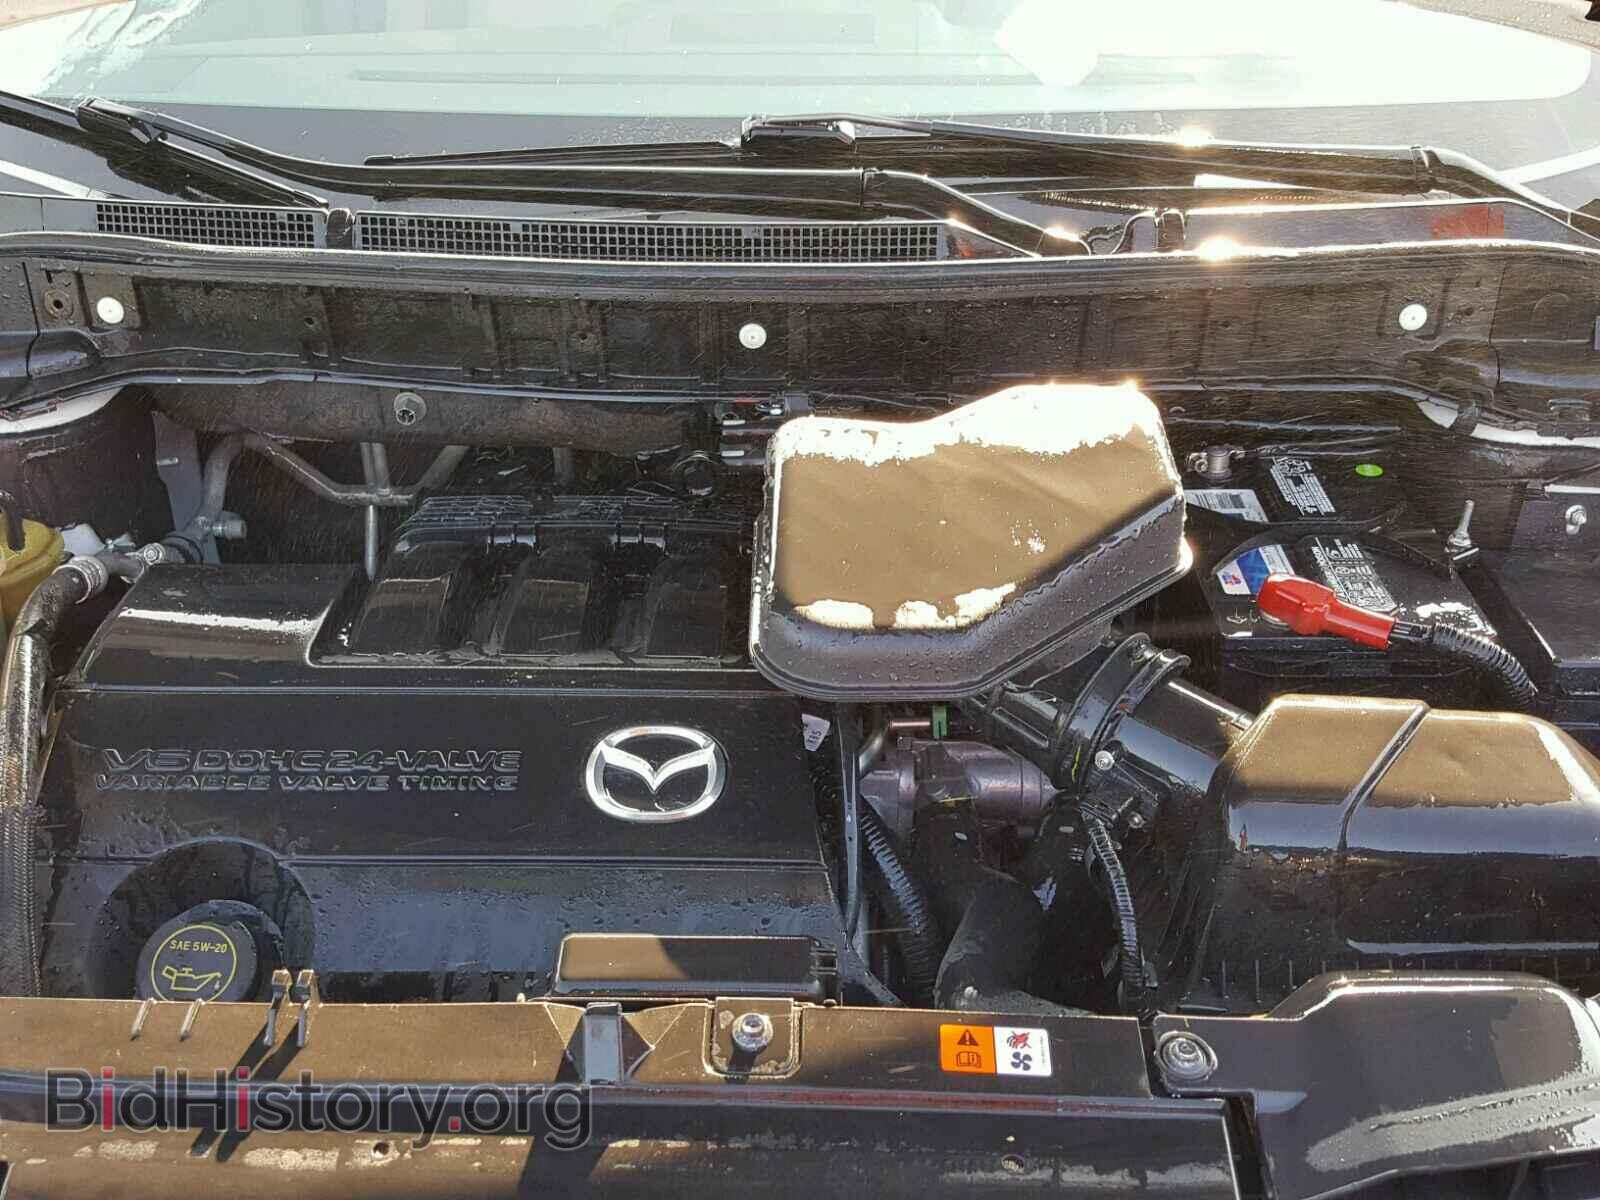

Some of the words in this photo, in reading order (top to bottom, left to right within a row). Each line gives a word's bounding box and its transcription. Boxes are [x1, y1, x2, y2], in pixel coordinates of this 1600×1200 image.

[103, 749, 190, 772] V6
[193, 750, 324, 772] DOHC
[326, 750, 522, 772] 24-VALVE
[96, 775, 271, 791] VARIABLE
[279, 775, 390, 791] VALVE
[397, 775, 519, 791] TIMING
[169, 939, 191, 951] SAE
[192, 941, 228, 953] 5W-20
